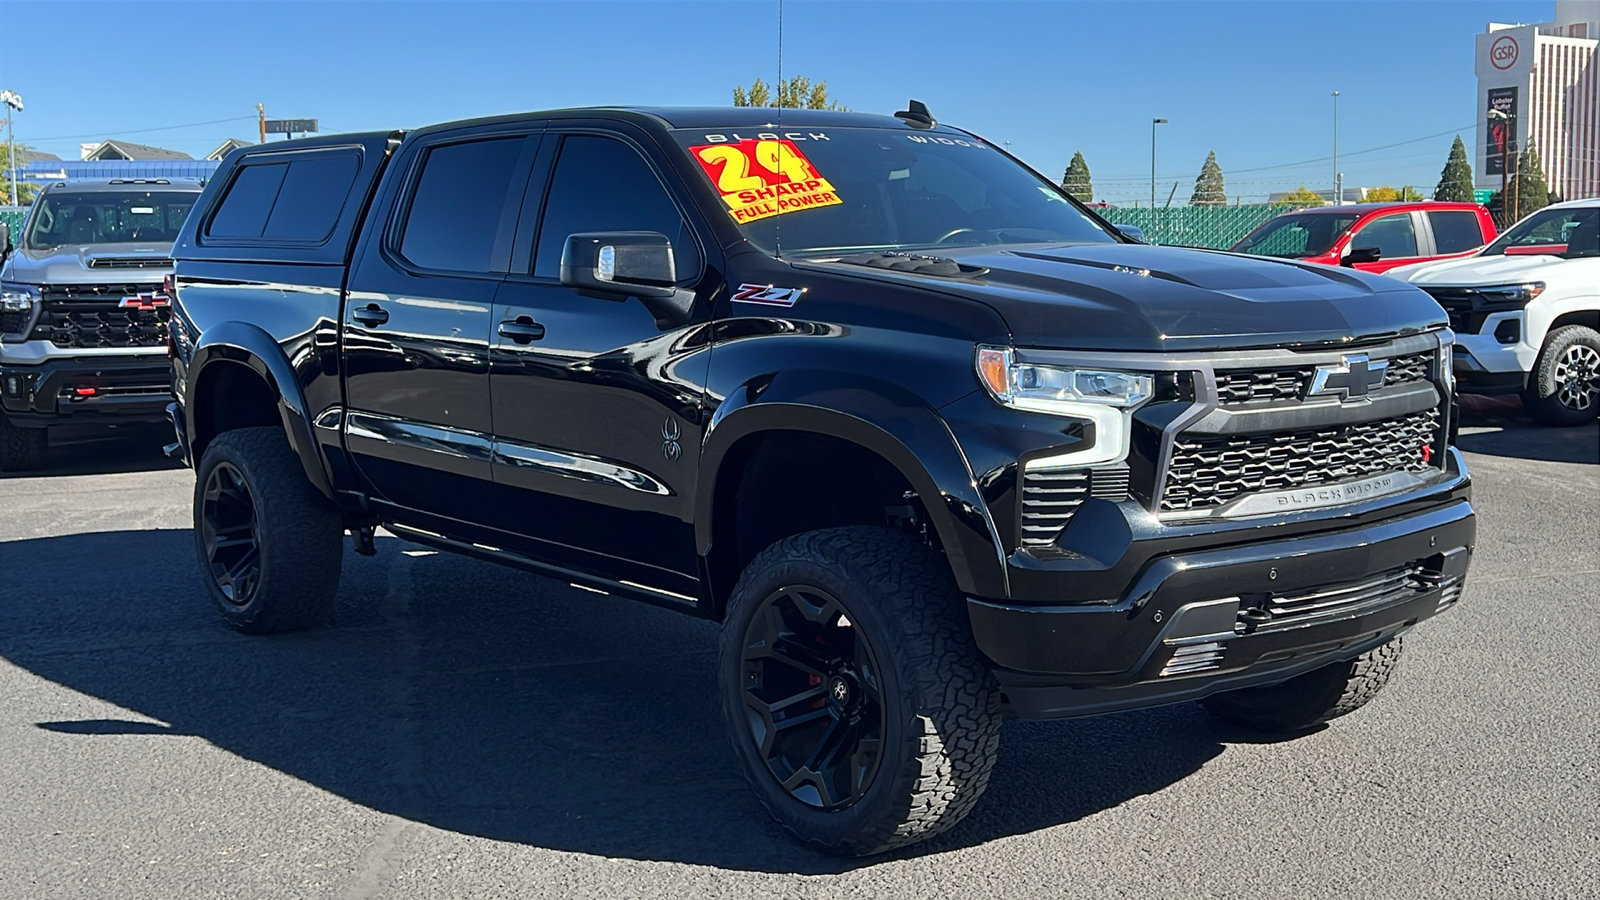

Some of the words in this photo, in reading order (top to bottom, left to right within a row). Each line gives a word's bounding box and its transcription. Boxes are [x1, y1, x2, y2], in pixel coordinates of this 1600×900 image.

[1493, 46, 1515, 61] GSR
[704, 132, 831, 143] BLACK
[906, 135, 986, 149] WIDOW
[698, 141, 814, 192] 24
[737, 180, 821, 204] SHARP
[734, 203, 776, 220] FULL
[777, 192, 835, 210] POWER
[730, 283, 804, 308] Z71
[1277, 489, 1342, 506] BLACK
[1346, 478, 1392, 495] WIDOW
